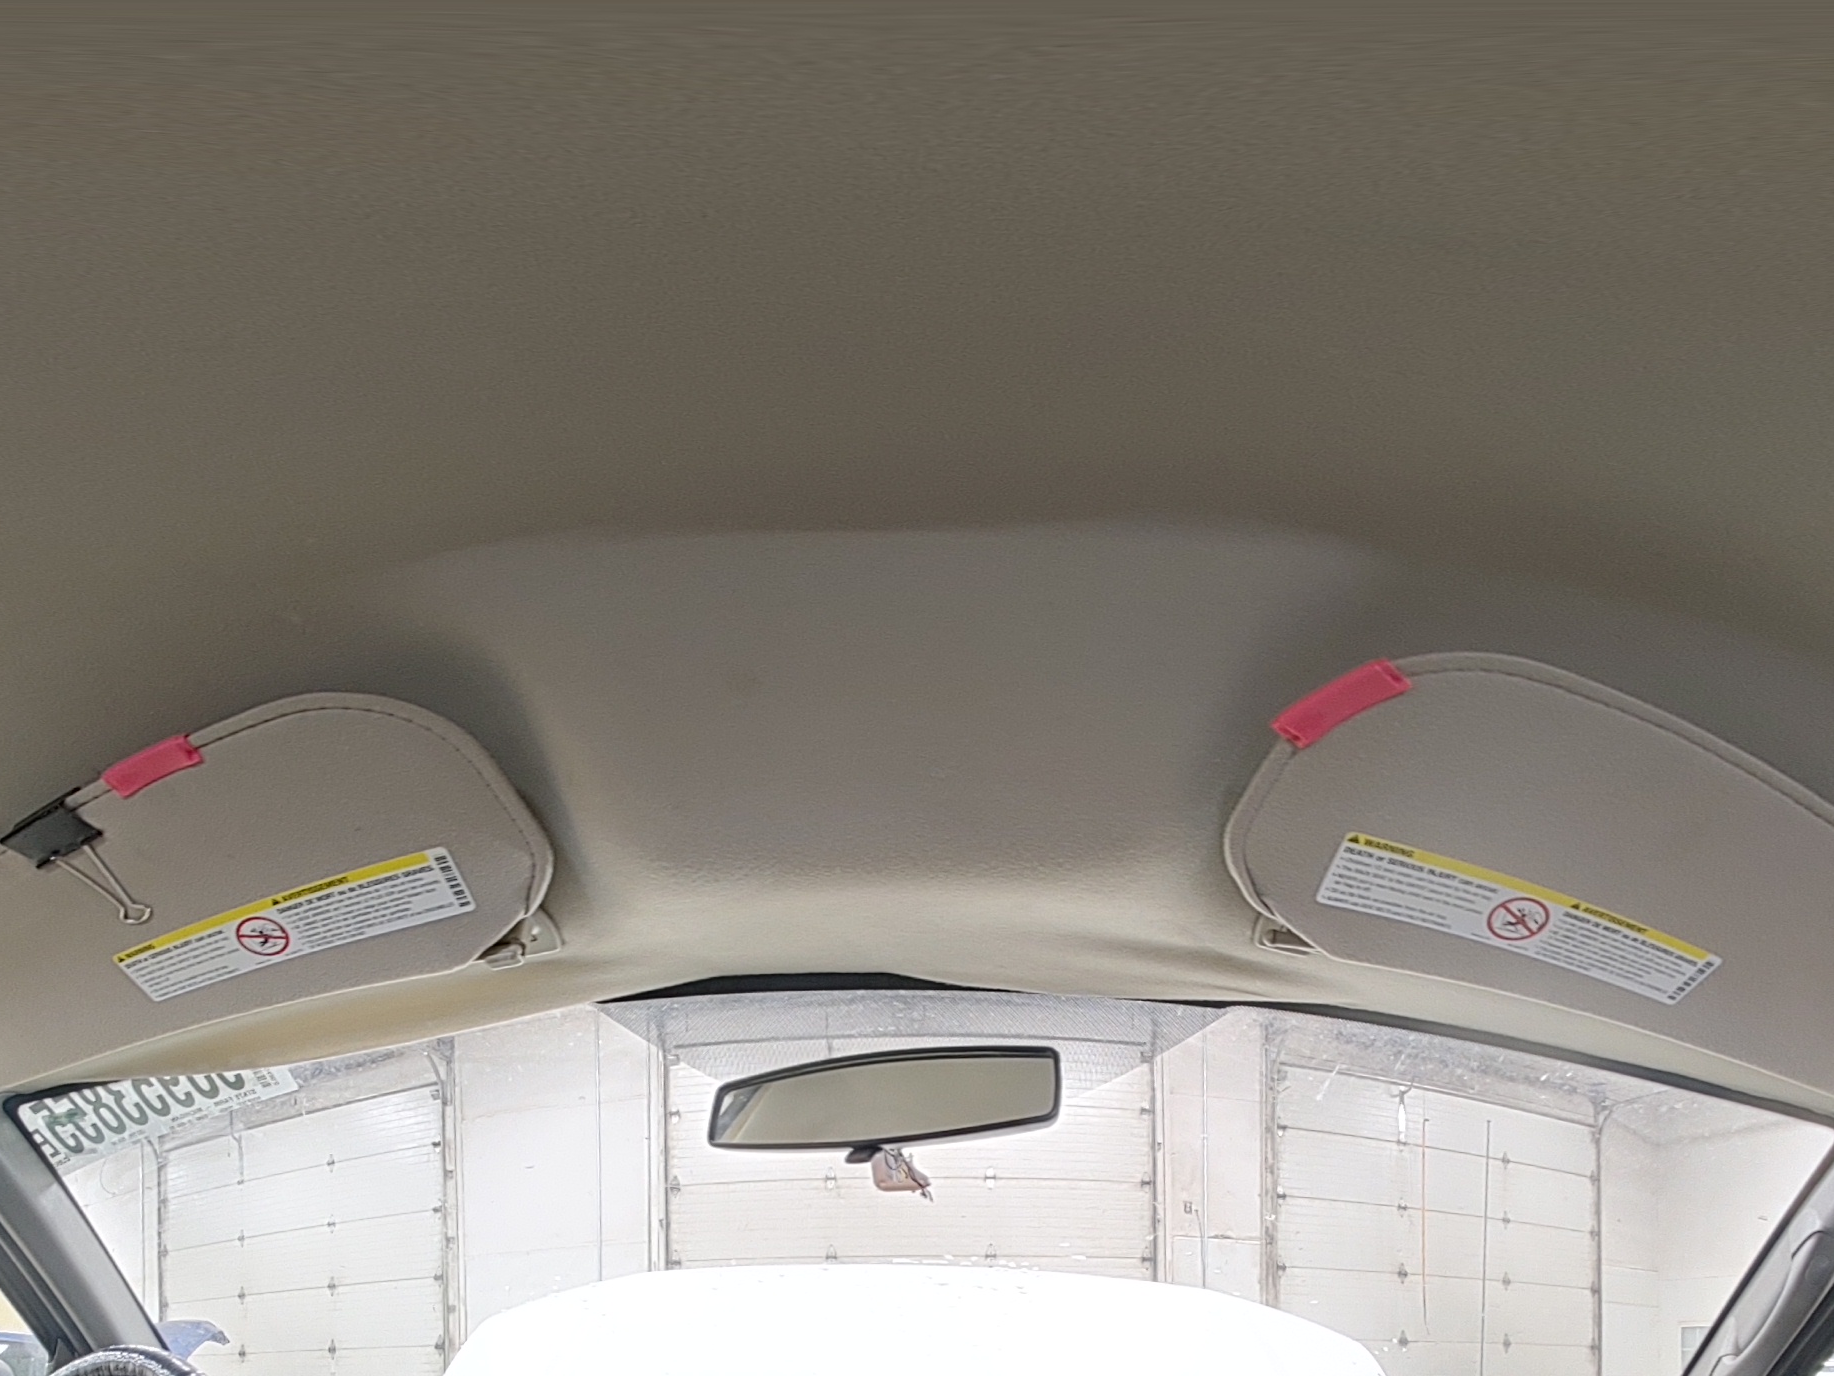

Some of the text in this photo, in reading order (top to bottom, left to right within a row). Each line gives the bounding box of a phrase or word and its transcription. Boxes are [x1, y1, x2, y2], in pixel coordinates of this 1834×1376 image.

[1343, 846, 1374, 860] DEATH
[1364, 837, 1415, 859] WARNING
[281, 875, 349, 902] AVERTISSEMENT
[124, 943, 156, 959] WARNING
